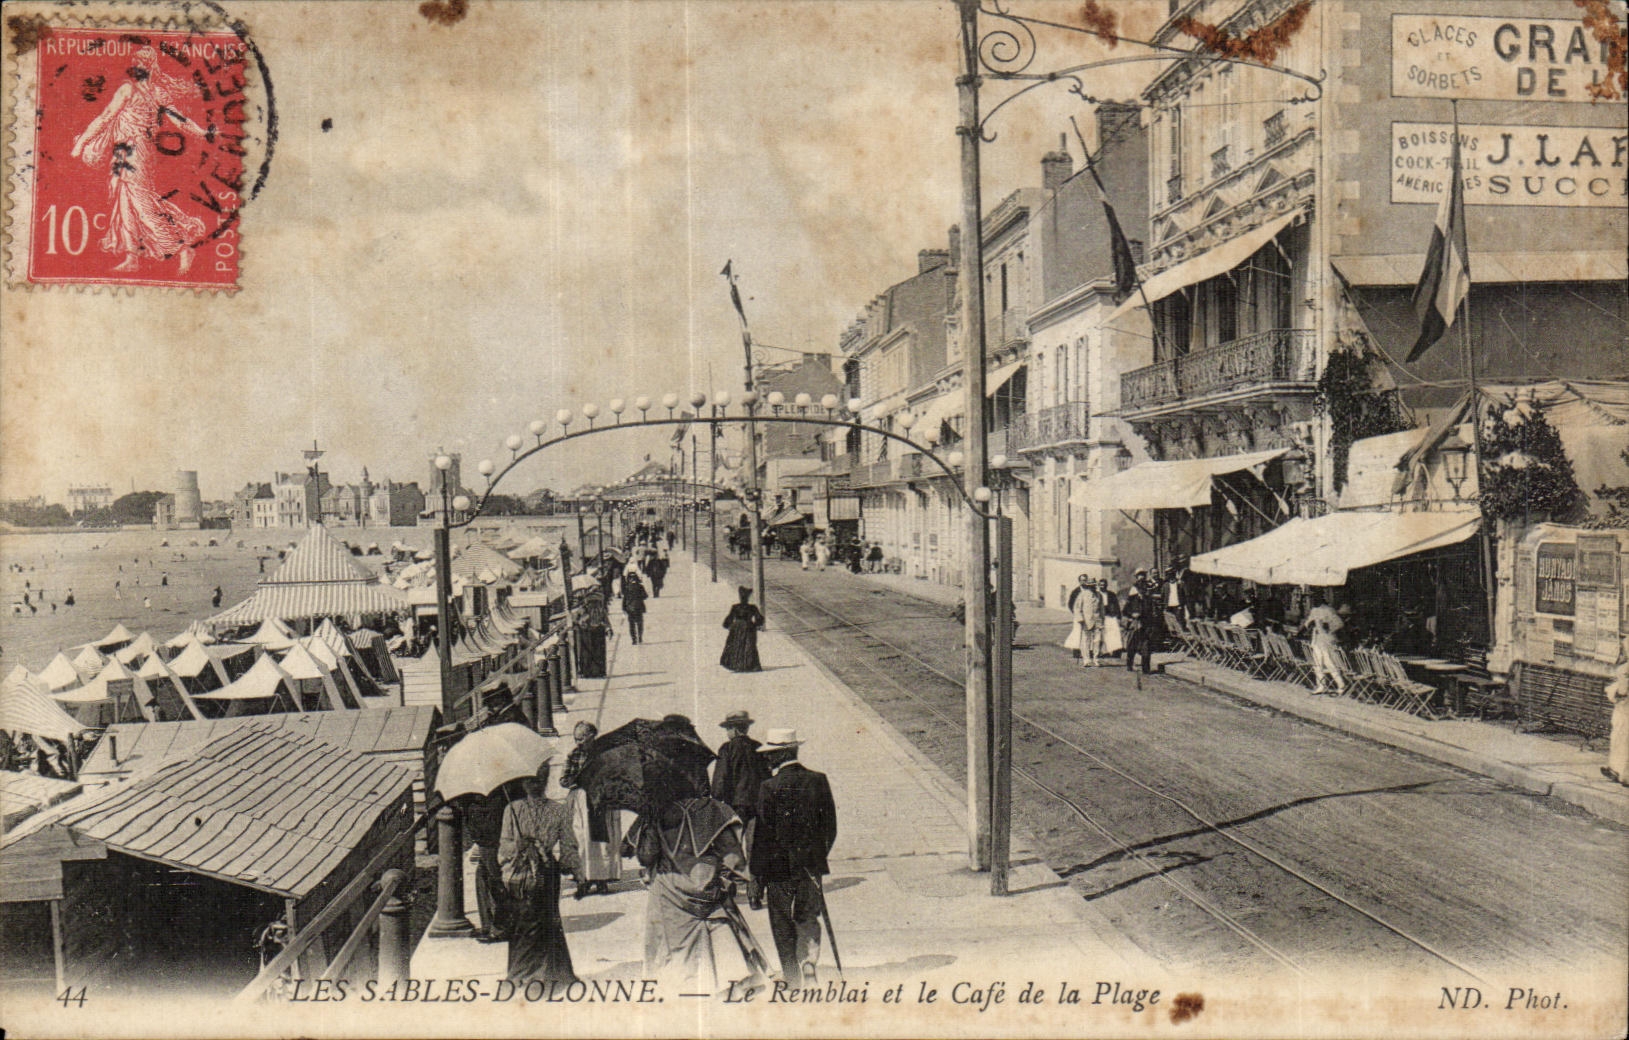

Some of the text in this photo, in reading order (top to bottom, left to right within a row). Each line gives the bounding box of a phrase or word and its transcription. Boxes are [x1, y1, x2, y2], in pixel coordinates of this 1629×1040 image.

[1407, 24, 1477, 48] GLACES
[1437, 52, 1451, 61] ET
[1407, 64, 1482, 90] SORBETS
[1516, 66, 1567, 97] DE
